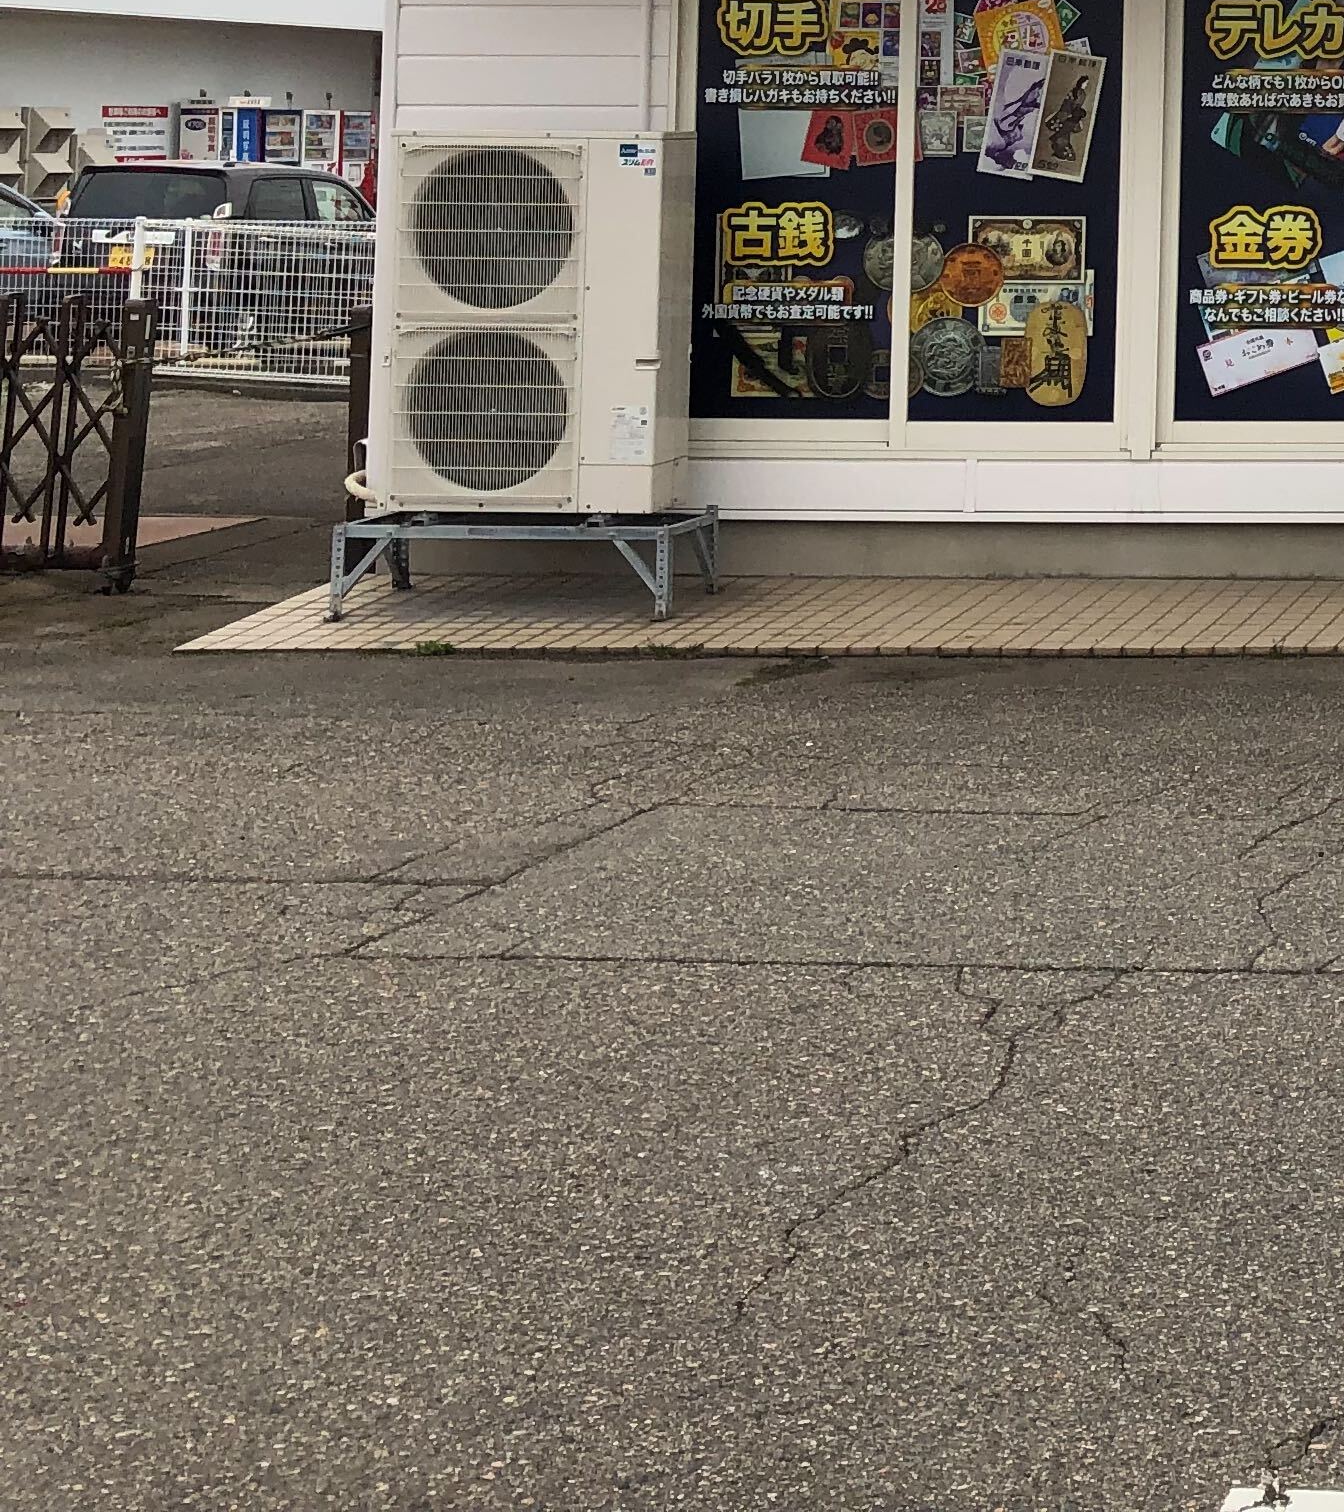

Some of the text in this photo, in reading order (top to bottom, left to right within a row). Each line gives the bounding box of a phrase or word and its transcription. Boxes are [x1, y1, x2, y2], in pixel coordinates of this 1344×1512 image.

[722, 69, 879, 86] 切手バラ1枚から買取可能!!
[704, 88, 896, 104] 書き損じハガキもお持ちください!!
[728, 207, 827, 260] 古銭
[1215, 211, 1316, 263] 金券
[732, 285, 845, 301] 記念硬貨やメダル類
[701, 304, 874, 320] 外国貨幣でもお査定可能です!!
